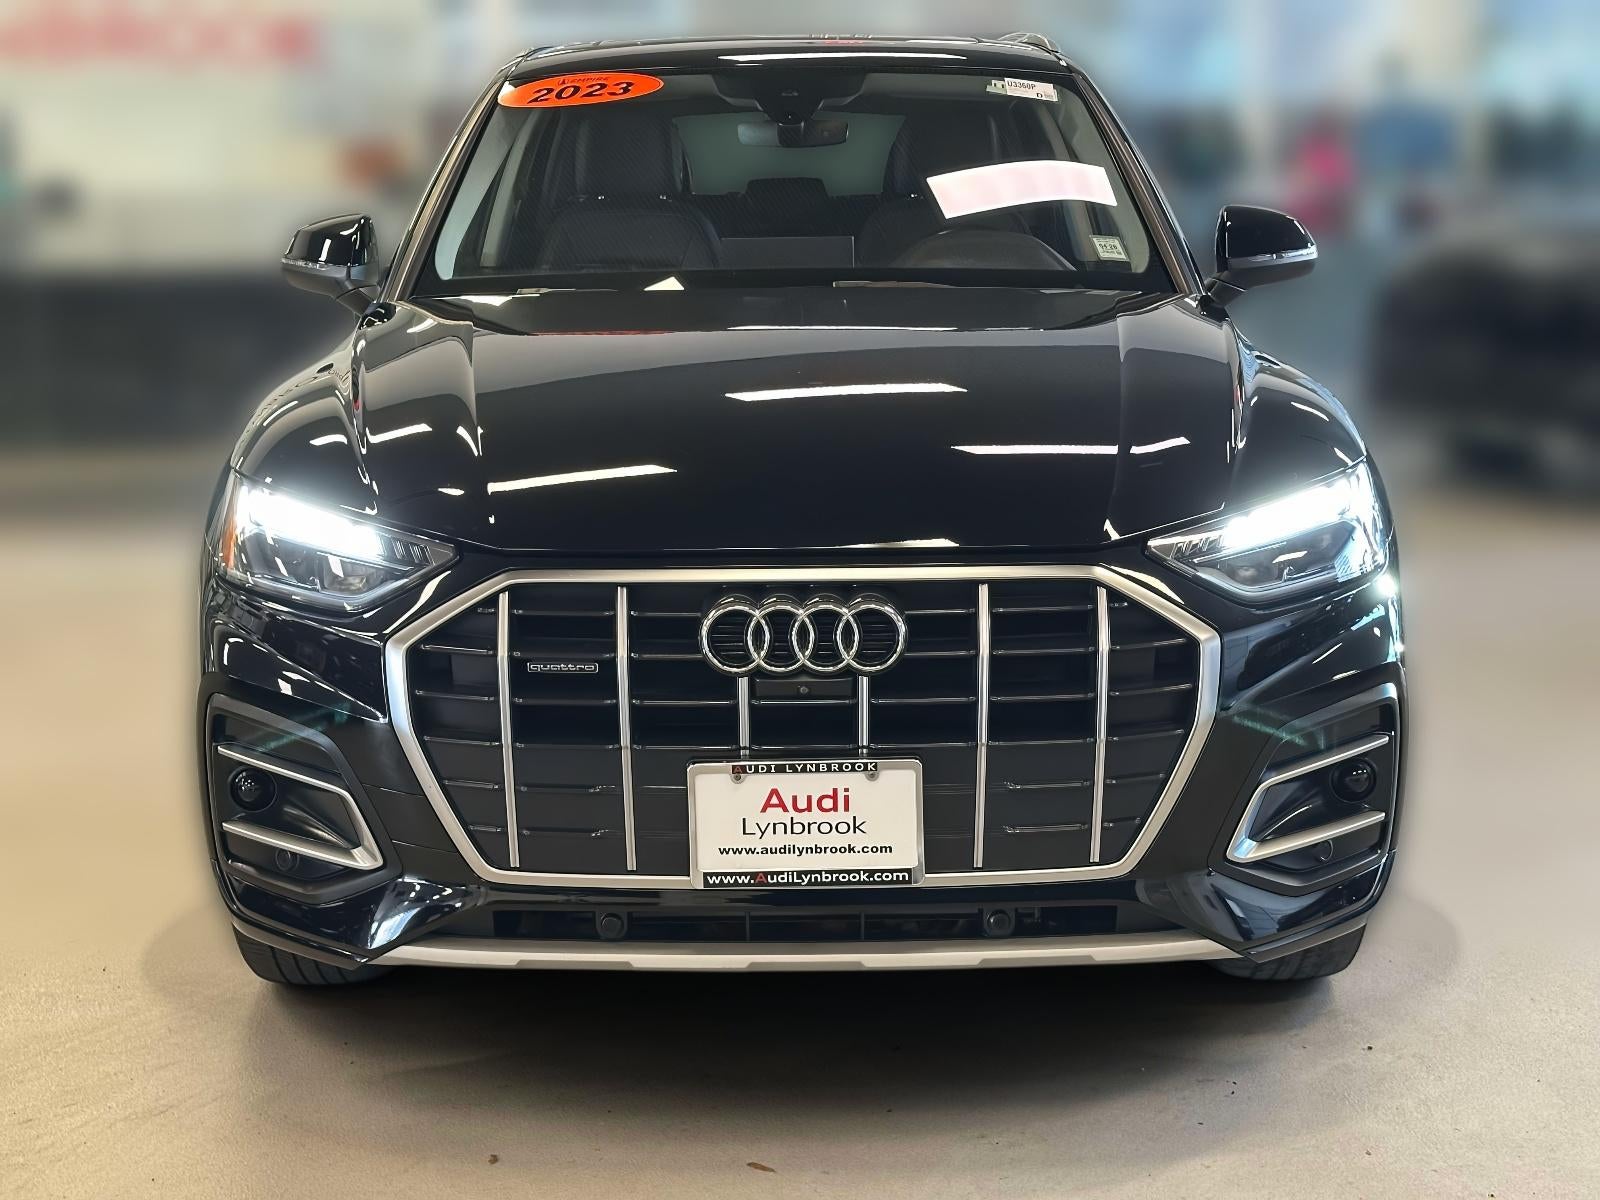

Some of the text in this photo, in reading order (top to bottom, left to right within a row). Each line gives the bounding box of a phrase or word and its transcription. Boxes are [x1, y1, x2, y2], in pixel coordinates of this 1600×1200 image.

[527, 82, 635, 104] 2023
[530, 663, 595, 672] quattro
[733, 762, 876, 774] AUDI LYNBROOK
[760, 788, 850, 813] Audi
[742, 816, 867, 839] Lynbrook
[718, 843, 893, 857] www.audilynbrook.com
[706, 871, 909, 886] www.AudiLynbrook.com
